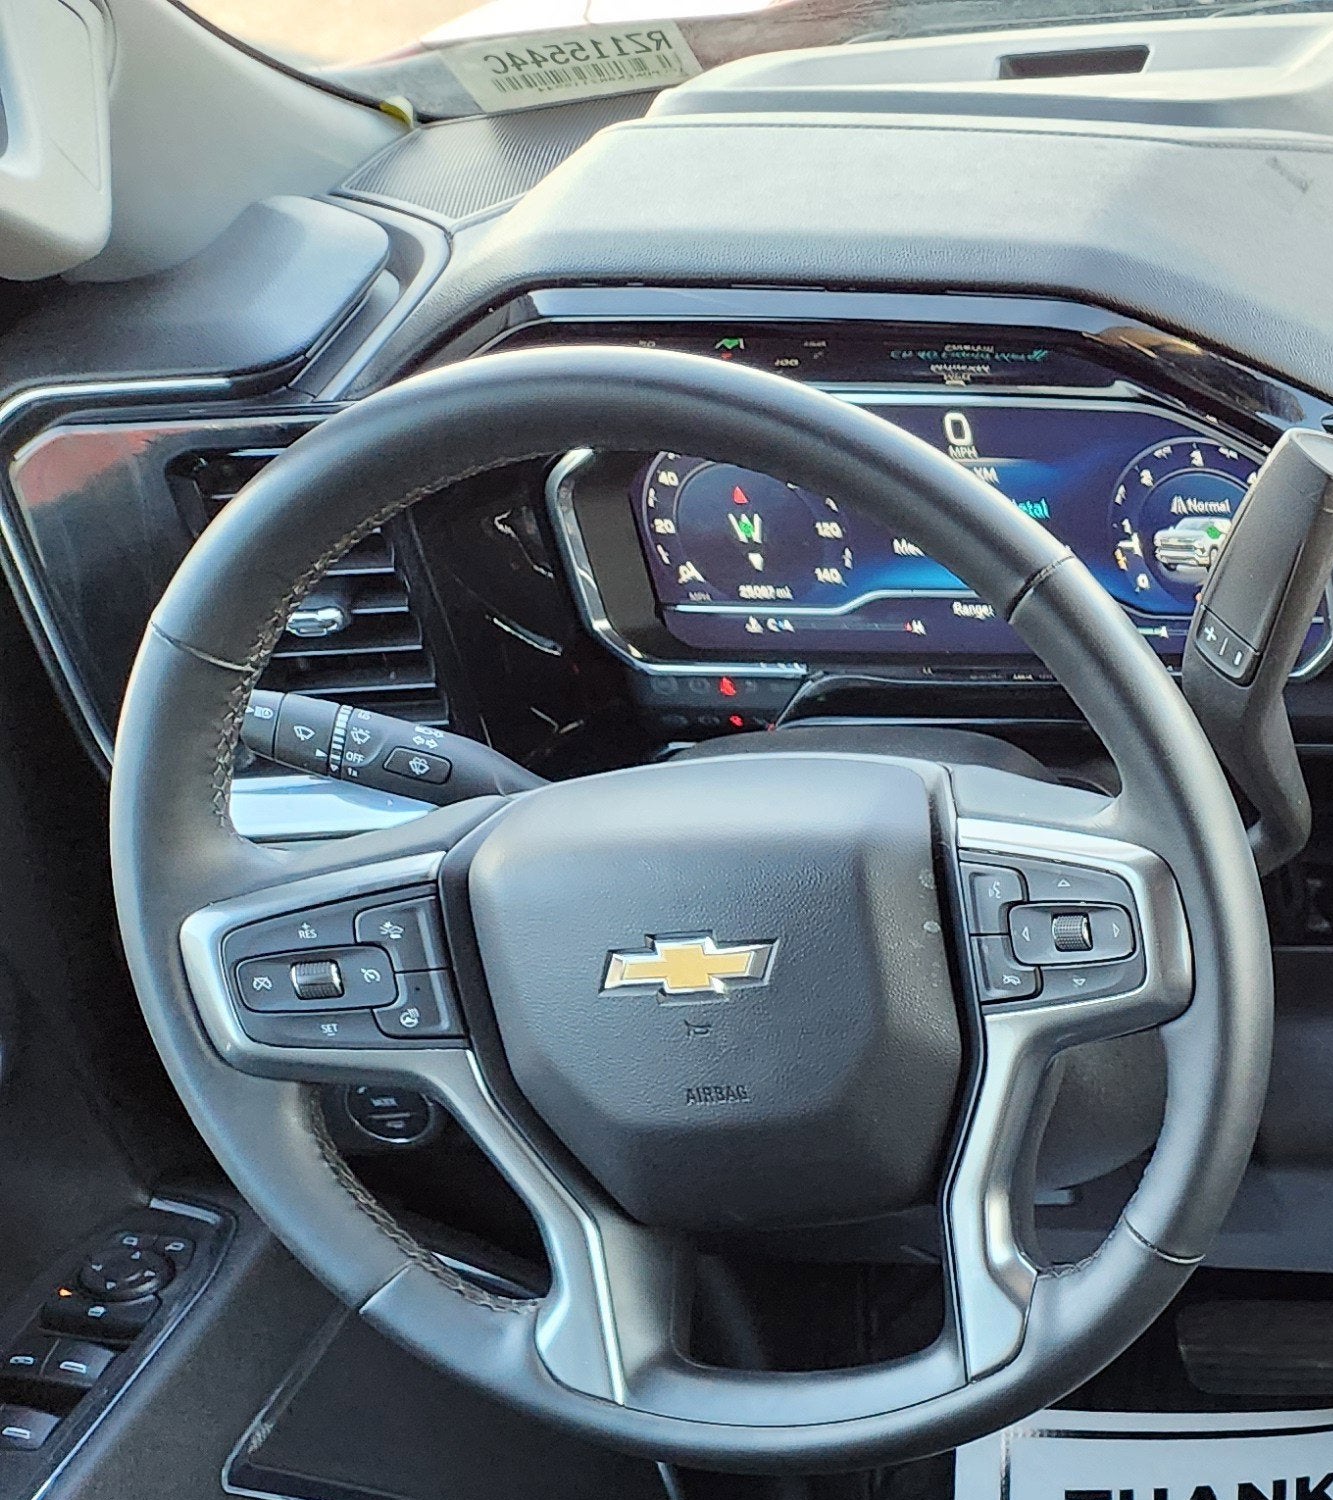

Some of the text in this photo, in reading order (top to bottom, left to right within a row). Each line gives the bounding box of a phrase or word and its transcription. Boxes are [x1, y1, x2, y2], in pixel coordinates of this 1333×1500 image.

[943, 412, 974, 446] 0
[949, 445, 978, 458] MPH
[659, 471, 679, 486] 40
[1187, 498, 1231, 514] Normal
[654, 518, 676, 533] 20
[815, 521, 843, 539] 120
[815, 567, 843, 585] 140
[345, 751, 365, 763] OFF
[298, 928, 318, 939] RES
[321, 1023, 339, 1034] SET
[686, 1085, 749, 1103] AIRBAG
